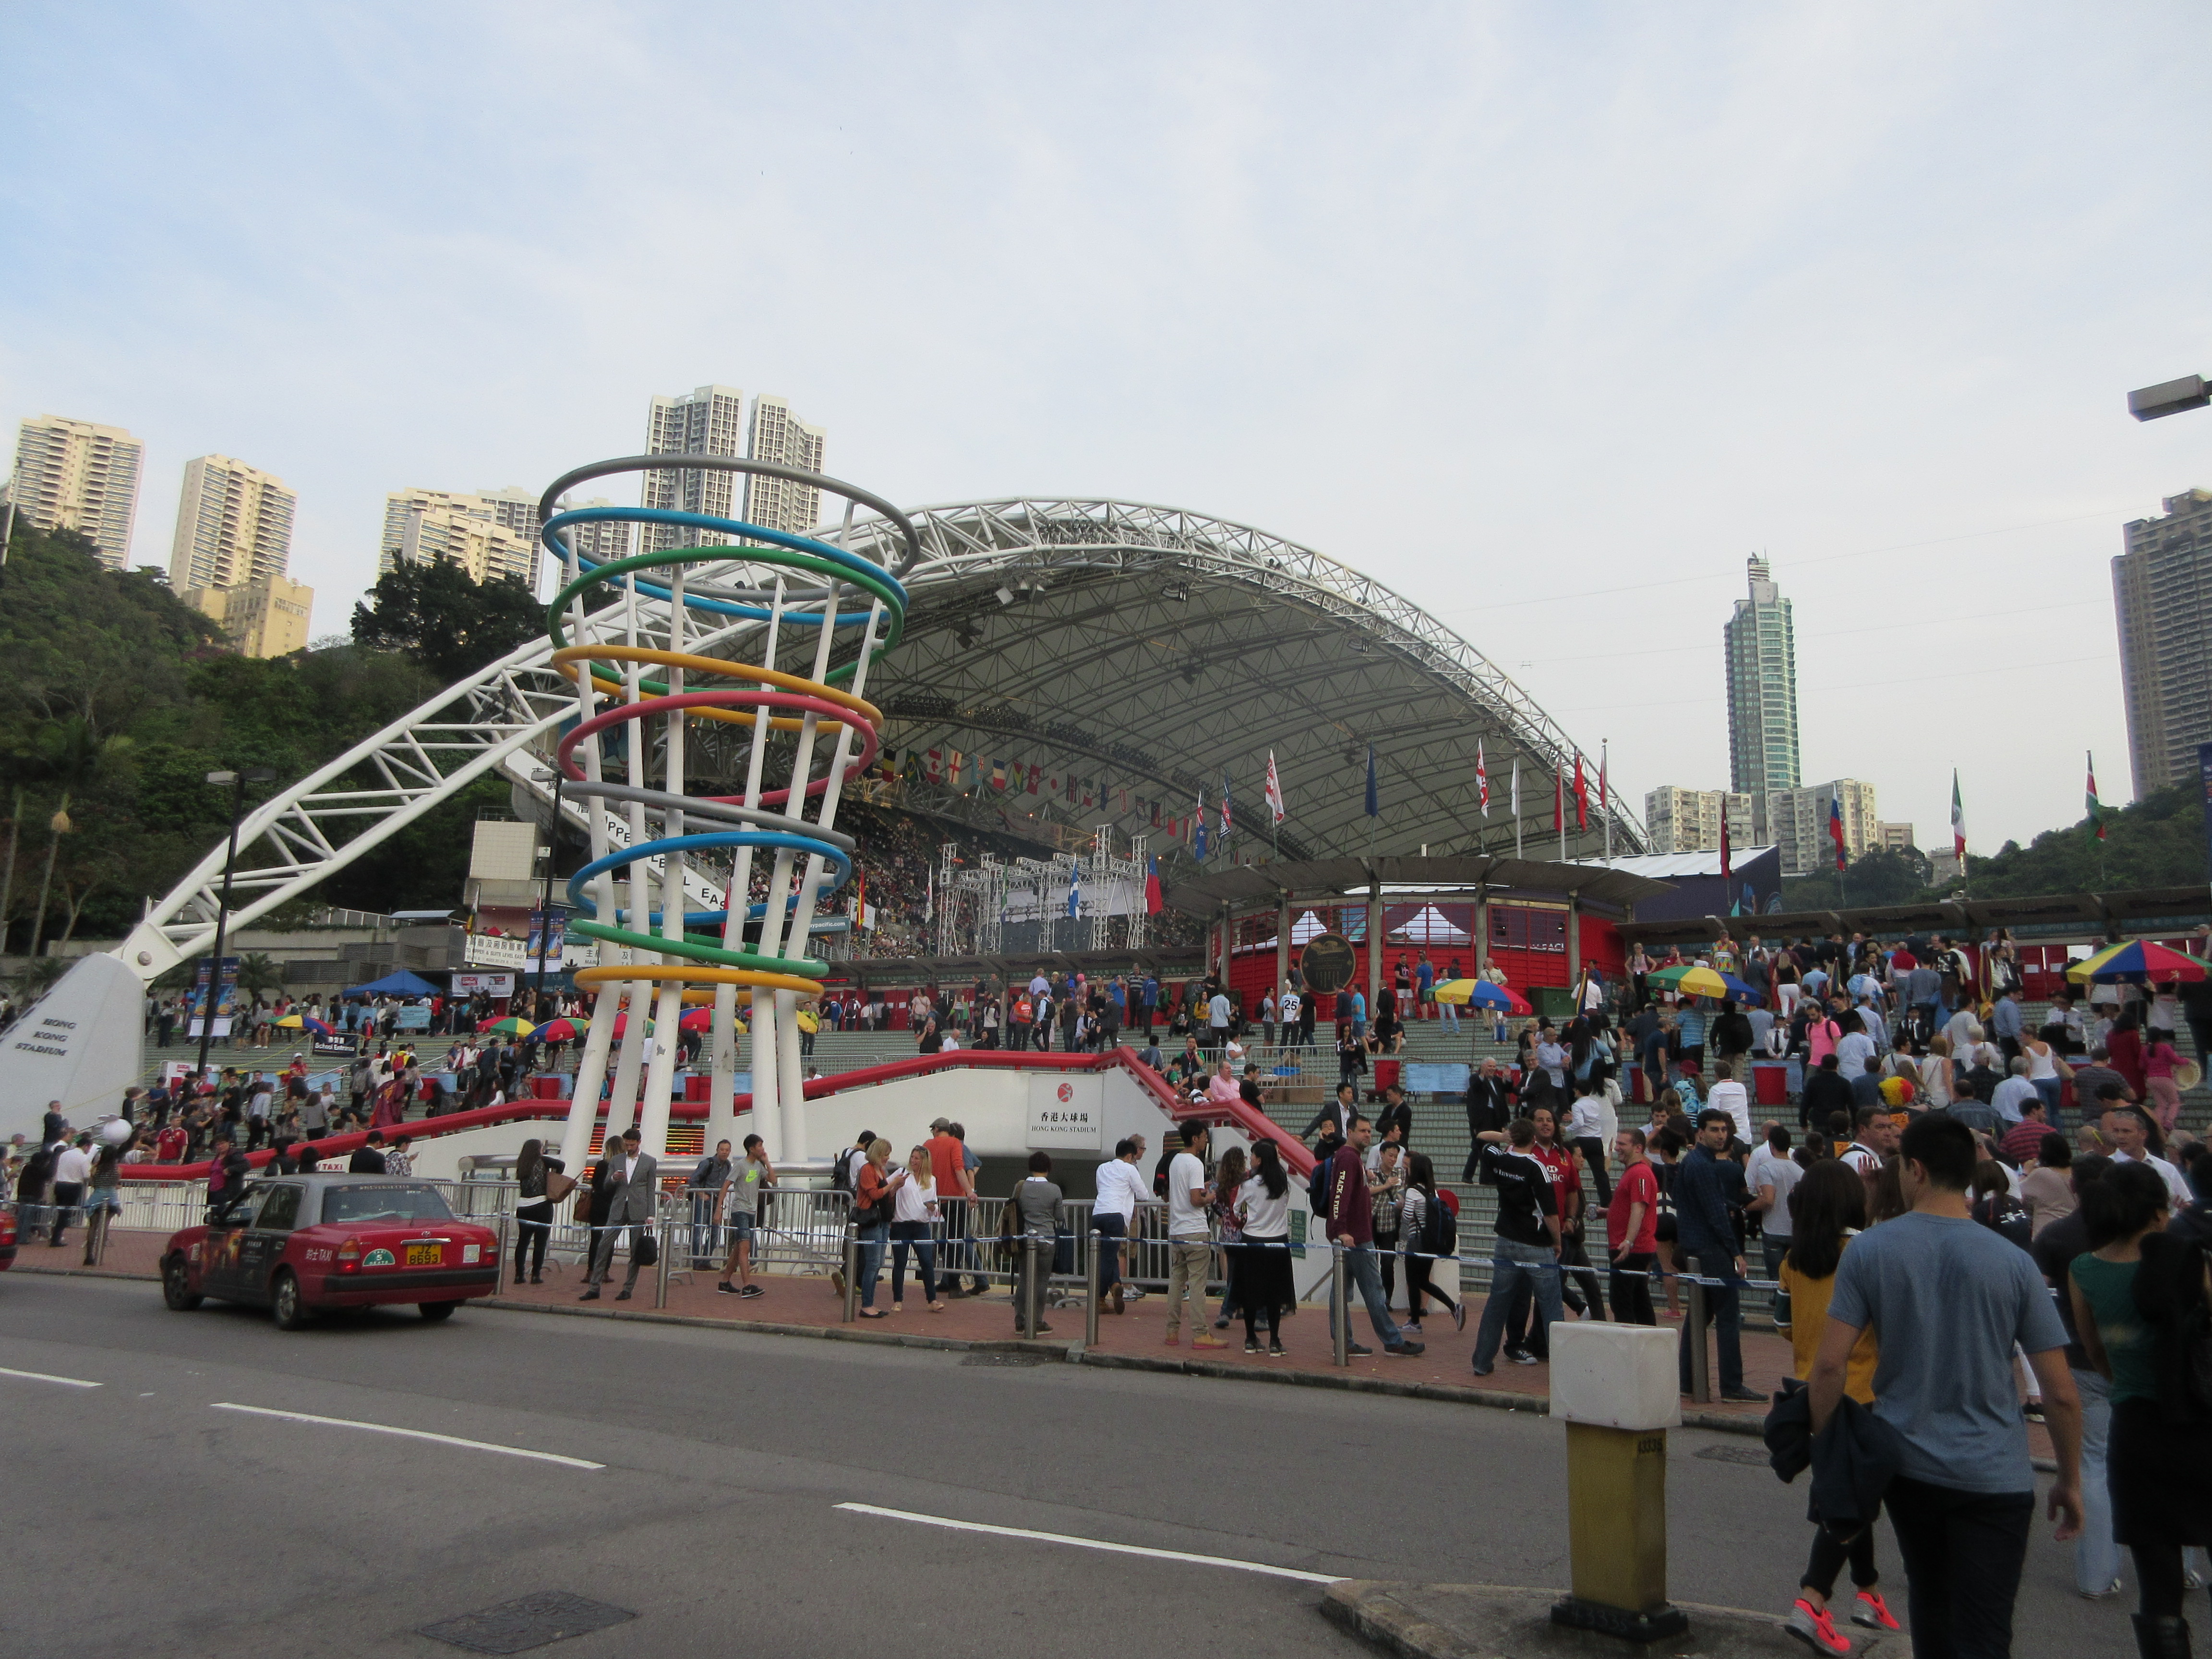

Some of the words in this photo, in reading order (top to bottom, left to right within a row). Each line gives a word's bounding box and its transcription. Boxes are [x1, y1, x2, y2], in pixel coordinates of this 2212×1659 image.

[701, 888, 725, 910] EAS
[1284, 999, 1298, 1010] 25
[42, 1018, 77, 1029] HONG
[33, 1031, 68, 1042] KONG
[15, 1042, 68, 1056] STADIUM
[1041, 1112, 1089, 1123] 香港大球場
[1499, 1169, 1526, 1181] Investec
[1549, 1173, 1564, 1182] SBC
[1336, 1170, 1346, 1194] TRACK
[418, 1245, 432, 1254] JZ
[319, 1249, 333, 1262] TAXI
[409, 1254, 439, 1264] 8693
